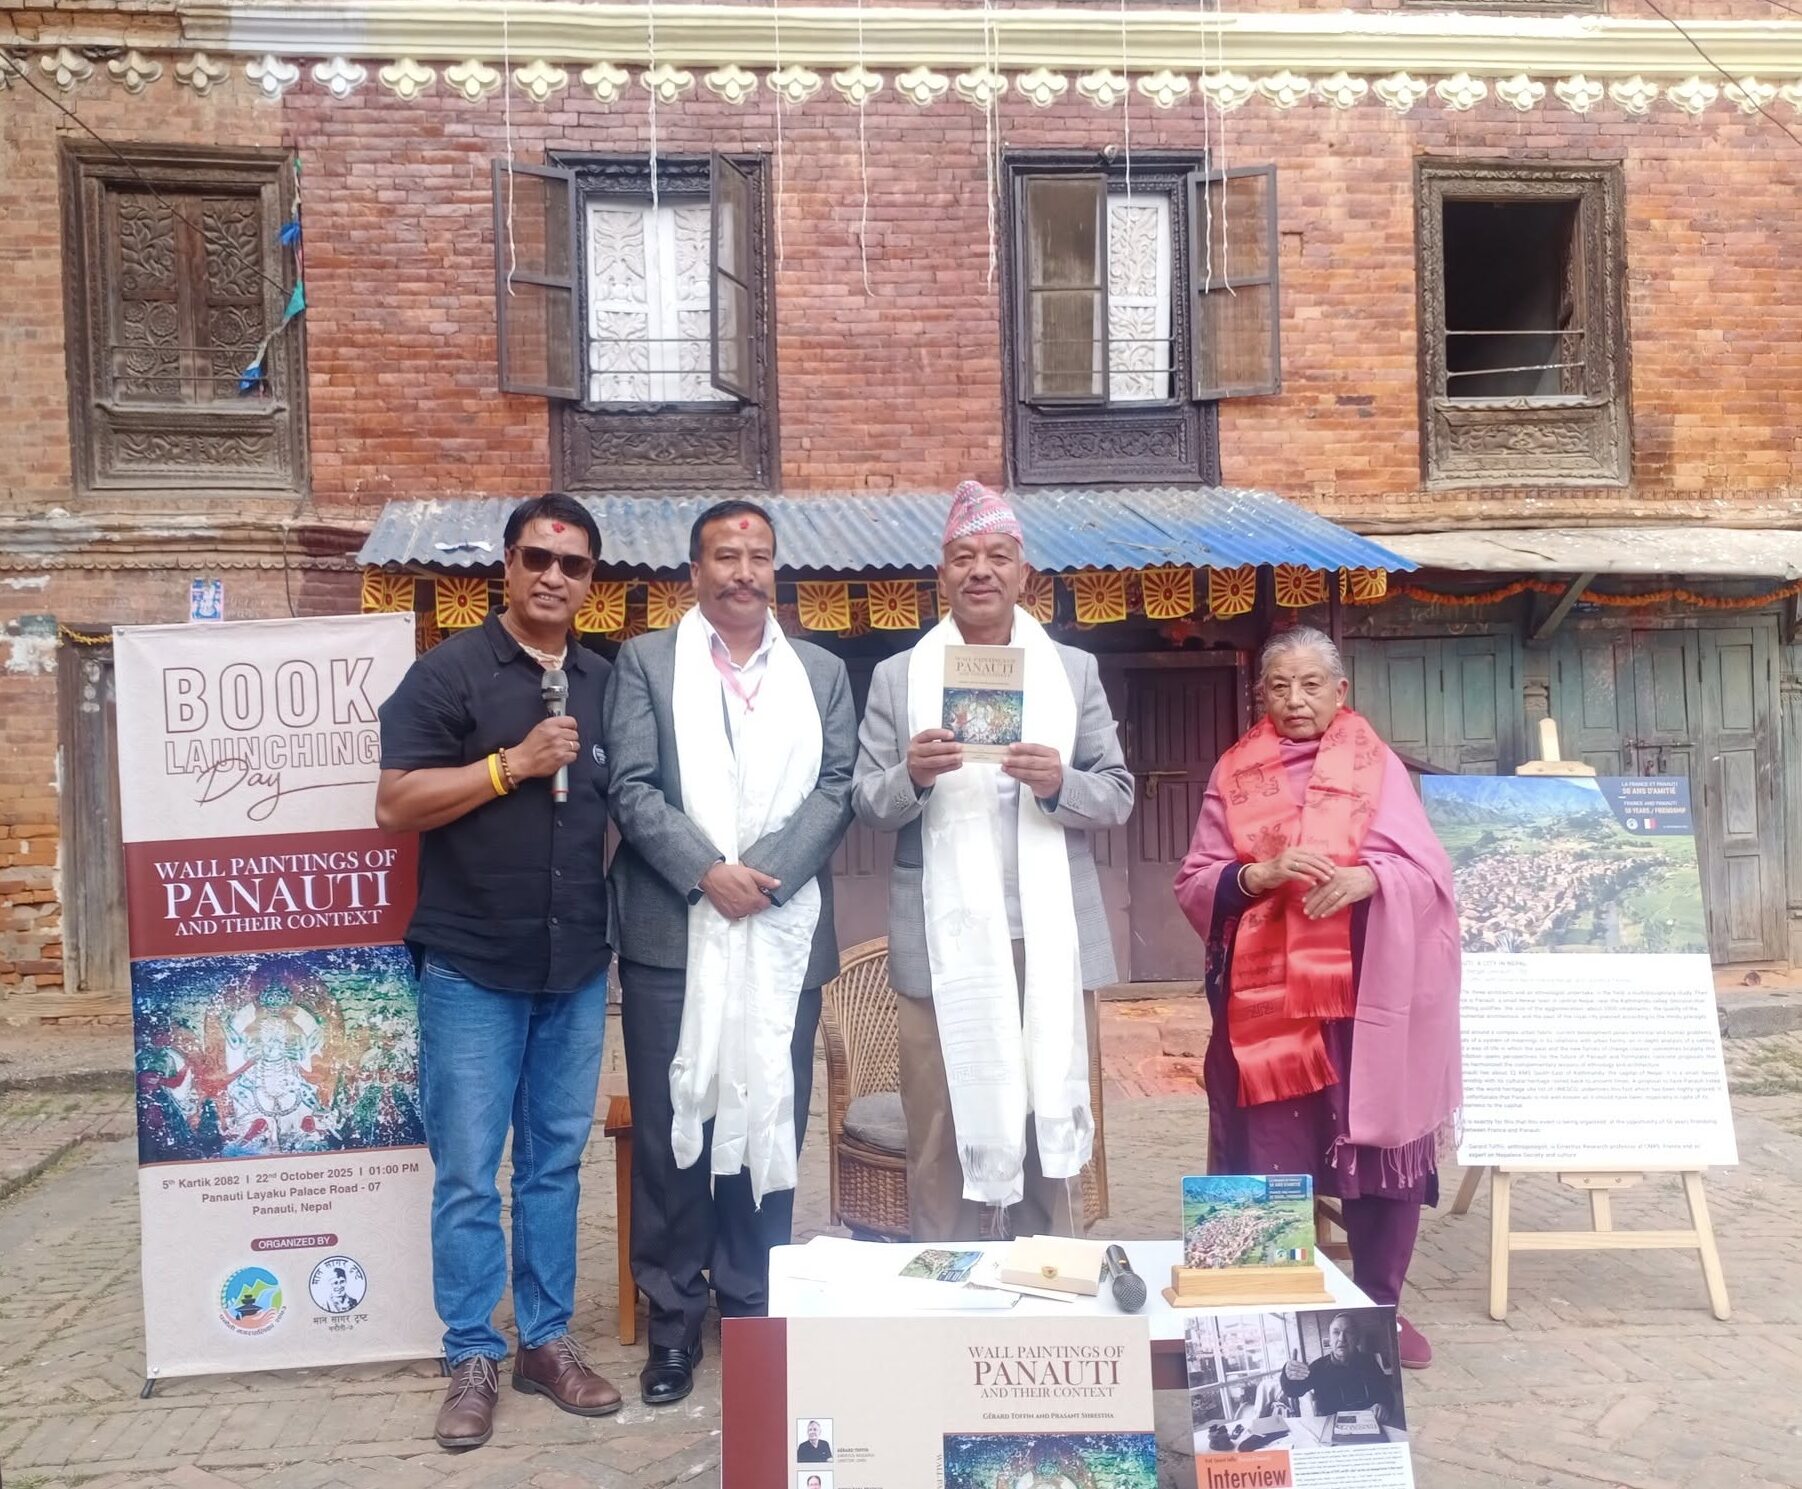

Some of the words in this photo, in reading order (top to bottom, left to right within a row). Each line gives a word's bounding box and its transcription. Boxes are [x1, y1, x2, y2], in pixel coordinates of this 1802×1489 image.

[163, 657, 378, 734] BOOK
[164, 730, 381, 775] LAUNCHING
[154, 858, 226, 880] WALL
[231, 851, 359, 876] PAINTINGS
[365, 849, 398, 868] OF
[162, 870, 392, 919] PANAUTI
[175, 920, 218, 936] AND
[221, 915, 282, 933] THEIR
[287, 909, 383, 930] CONTEXT
[178, 1177, 211, 1189] Kartik
[214, 1175, 240, 1186] 2082
[280, 1169, 324, 1182] October
[327, 1168, 353, 1178] 2025
[368, 1164, 399, 1175] 01:00
[402, 1163, 419, 1173] PM
[201, 1191, 243, 1203] Panauti
[247, 1188, 286, 1202] Layaku
[290, 1186, 326, 1197] Palace
[329, 1183, 358, 1195] Road
[368, 1182, 381, 1192] 07
[252, 1203, 298, 1216] Panauti,
[301, 1201, 332, 1214] Nepal
[258, 1237, 314, 1249] ORGANIZED
[317, 1236, 332, 1246] BY
[968, 1346, 1014, 1359] WALL
[1017, 1345, 1100, 1359] PAINTINGS
[1103, 1345, 1125, 1358] OF
[973, 1360, 1121, 1386] PANAUTI
[980, 1387, 1008, 1399] AND
[1011, 1386, 1050, 1398] THEIR
[1053, 1386, 1115, 1398] CONTEXT
[1207, 1465, 1286, 1489] Interview
